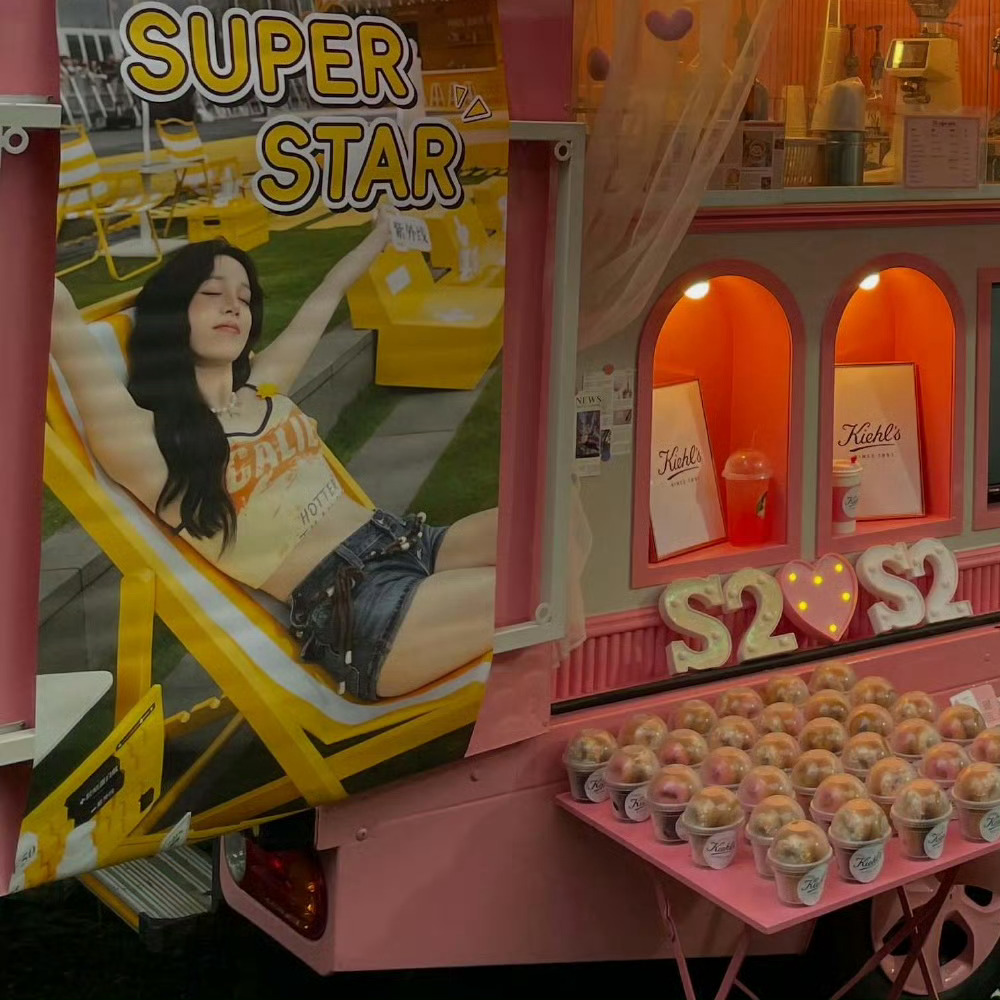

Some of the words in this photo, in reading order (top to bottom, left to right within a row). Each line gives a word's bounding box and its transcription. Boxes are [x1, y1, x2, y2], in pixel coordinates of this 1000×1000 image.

[120, 2, 417, 104] SUPER
[254, 115, 467, 210] STAR
[657, 444, 702, 476] Kiehl's
[838, 421, 902, 447] Kiehl's
[658, 566, 799, 676] S2
[856, 537, 974, 637] S2
